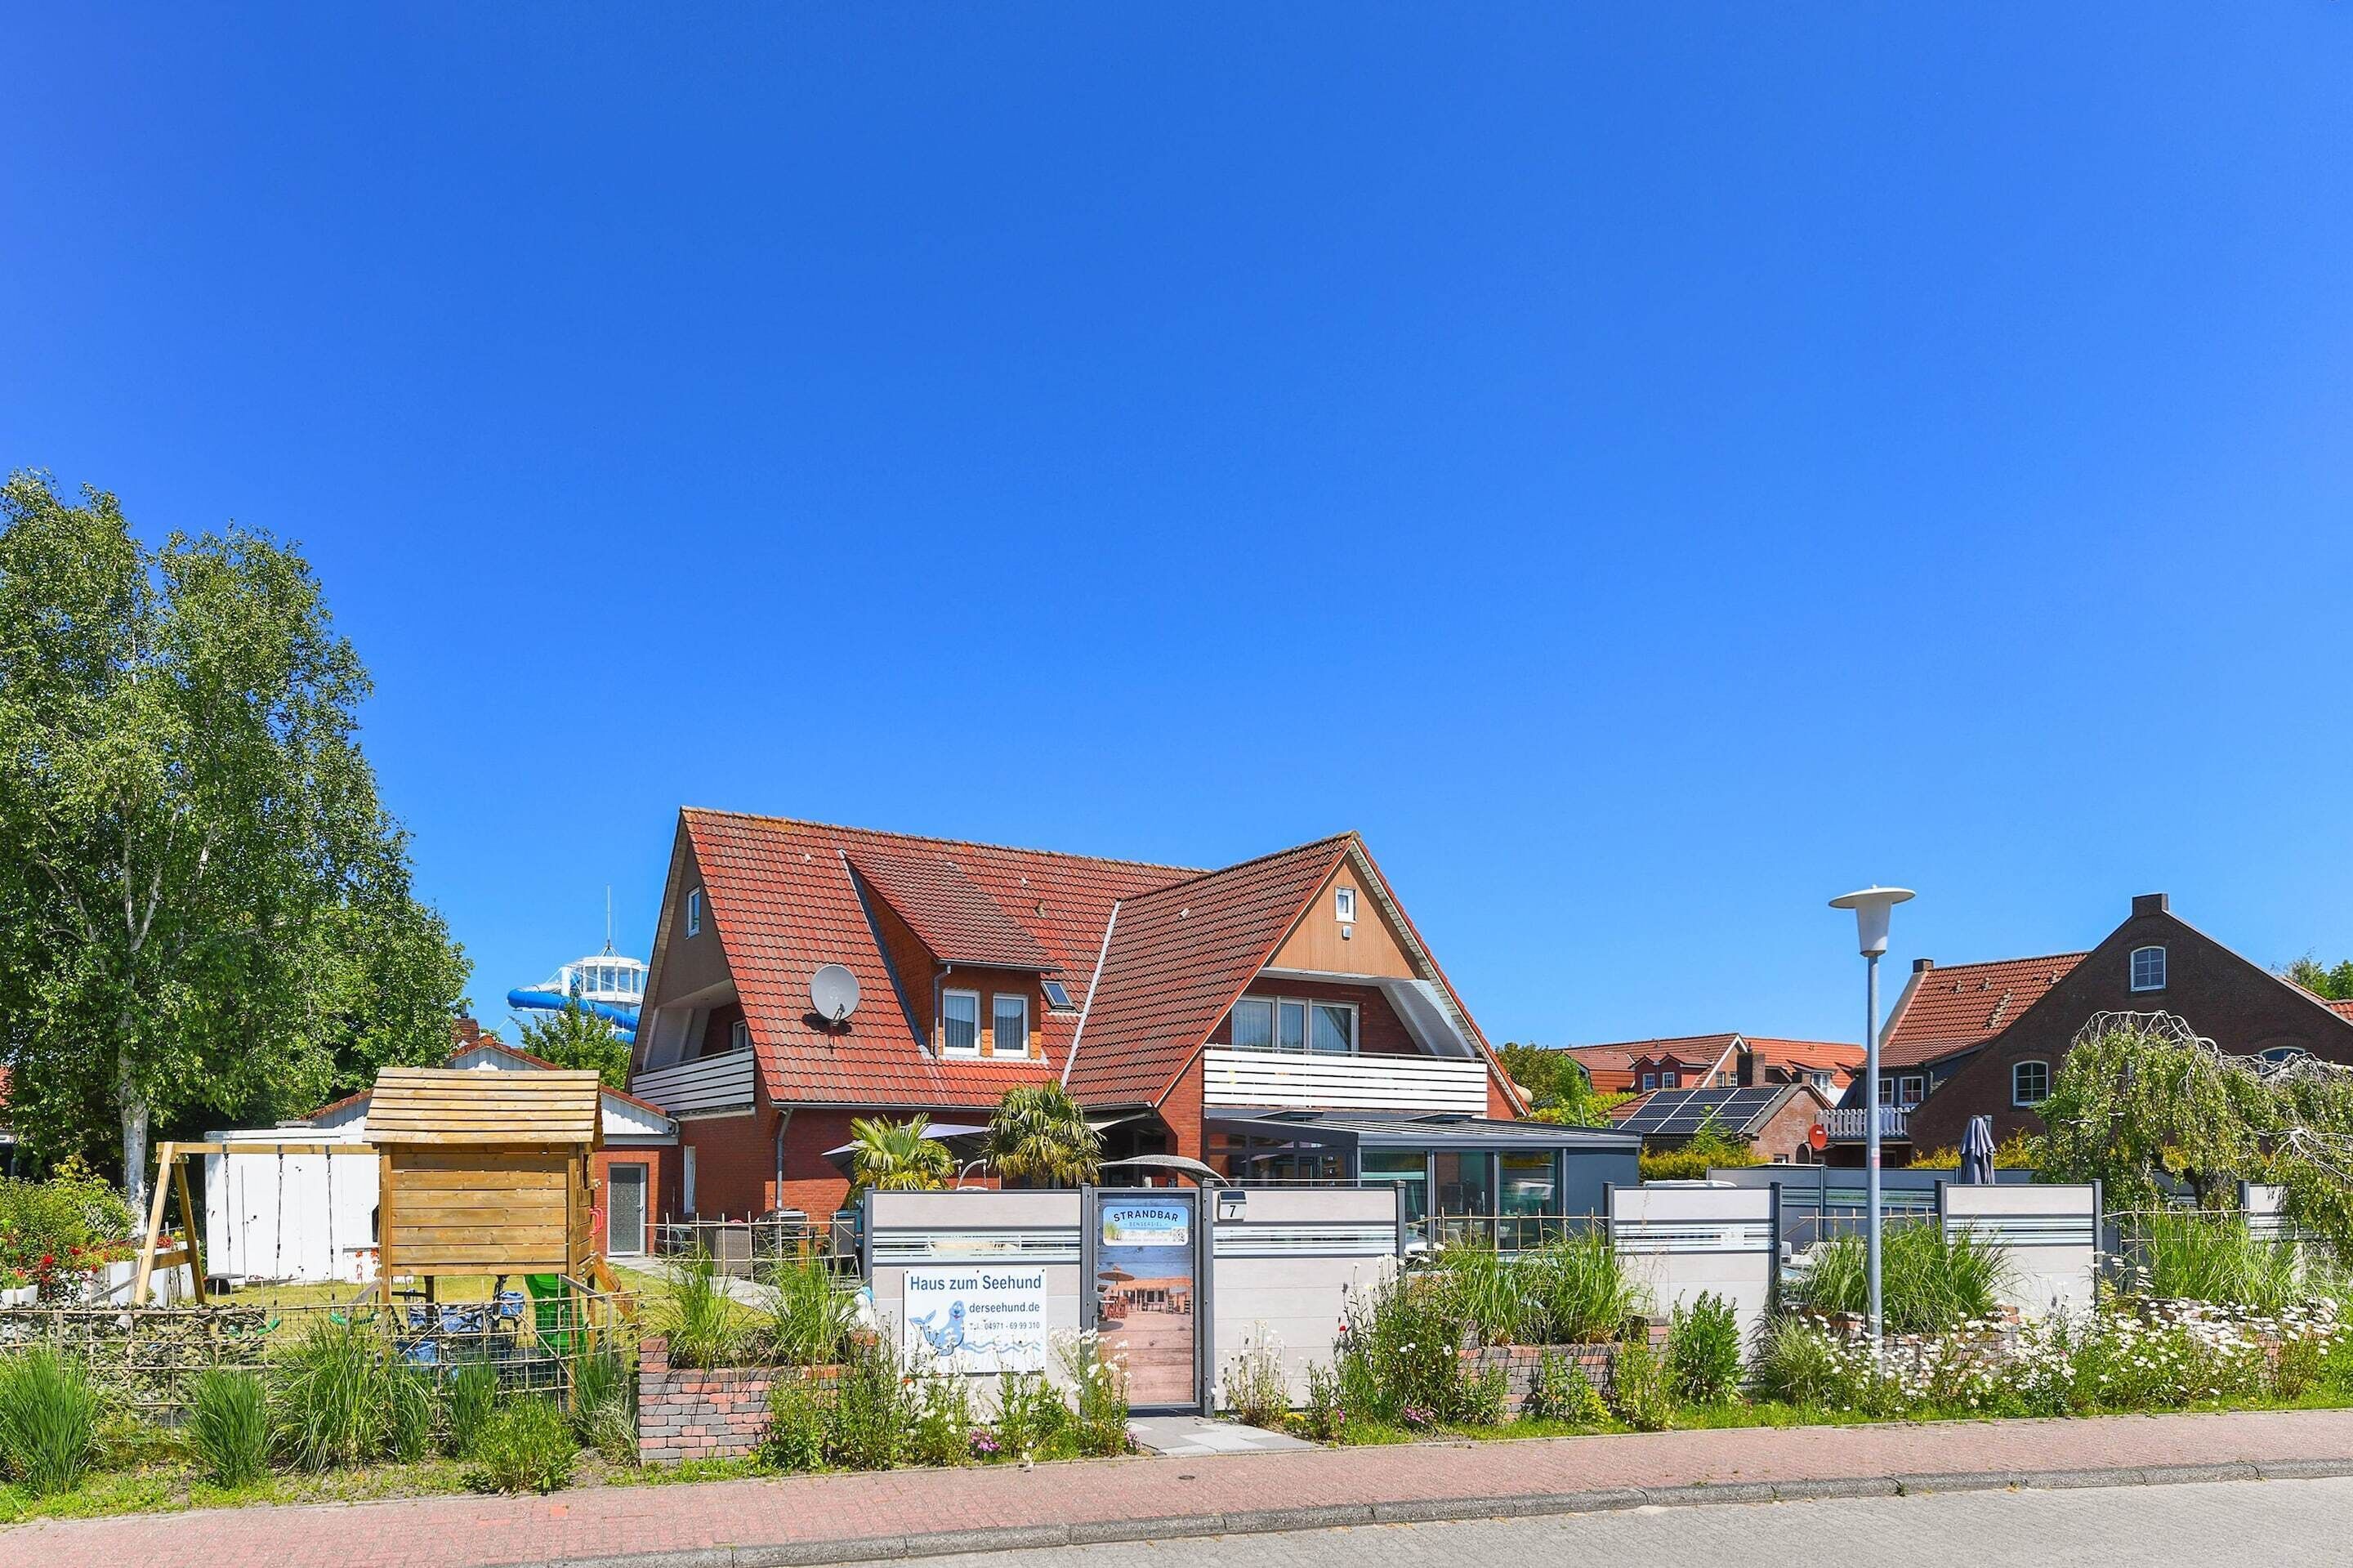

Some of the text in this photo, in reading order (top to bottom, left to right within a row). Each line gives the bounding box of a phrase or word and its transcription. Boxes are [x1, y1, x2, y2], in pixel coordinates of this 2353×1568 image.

[1114, 1210, 1179, 1222] STRANDBAR
[1230, 1205, 1236, 1217] 7
[910, 1275, 1042, 1290] Haus zum Seehund
[969, 1302, 1040, 1312] derseehund.de
[984, 1322, 1003, 1330] 04971
[1029, 1321, 1040, 1329] 310
